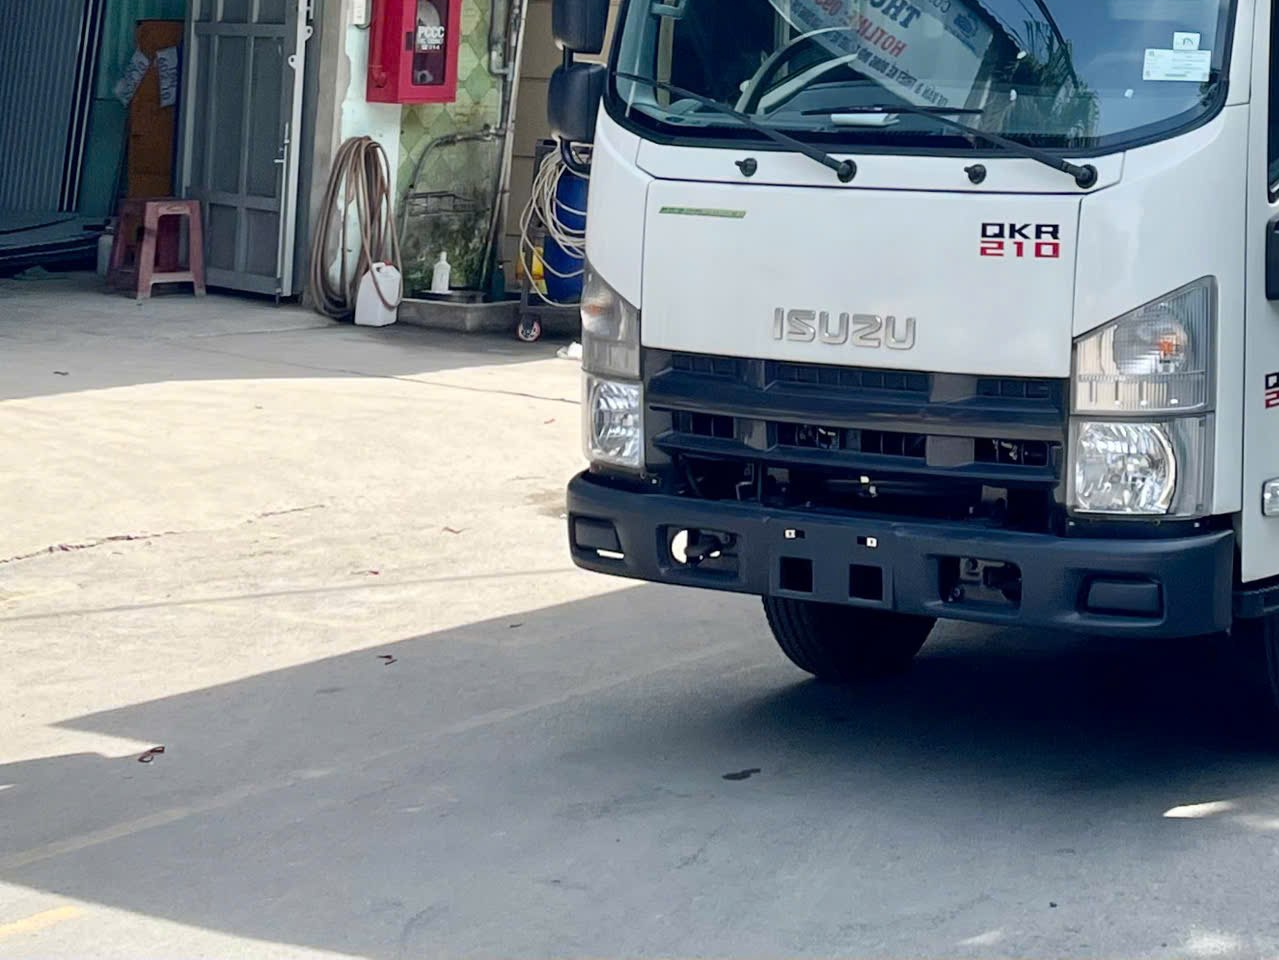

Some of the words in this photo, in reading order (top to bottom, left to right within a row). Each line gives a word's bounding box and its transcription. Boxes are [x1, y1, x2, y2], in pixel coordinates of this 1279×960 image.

[981, 222, 1060, 240] QKR
[980, 240, 1060, 258] 210
[773, 307, 916, 351] ISUZU
